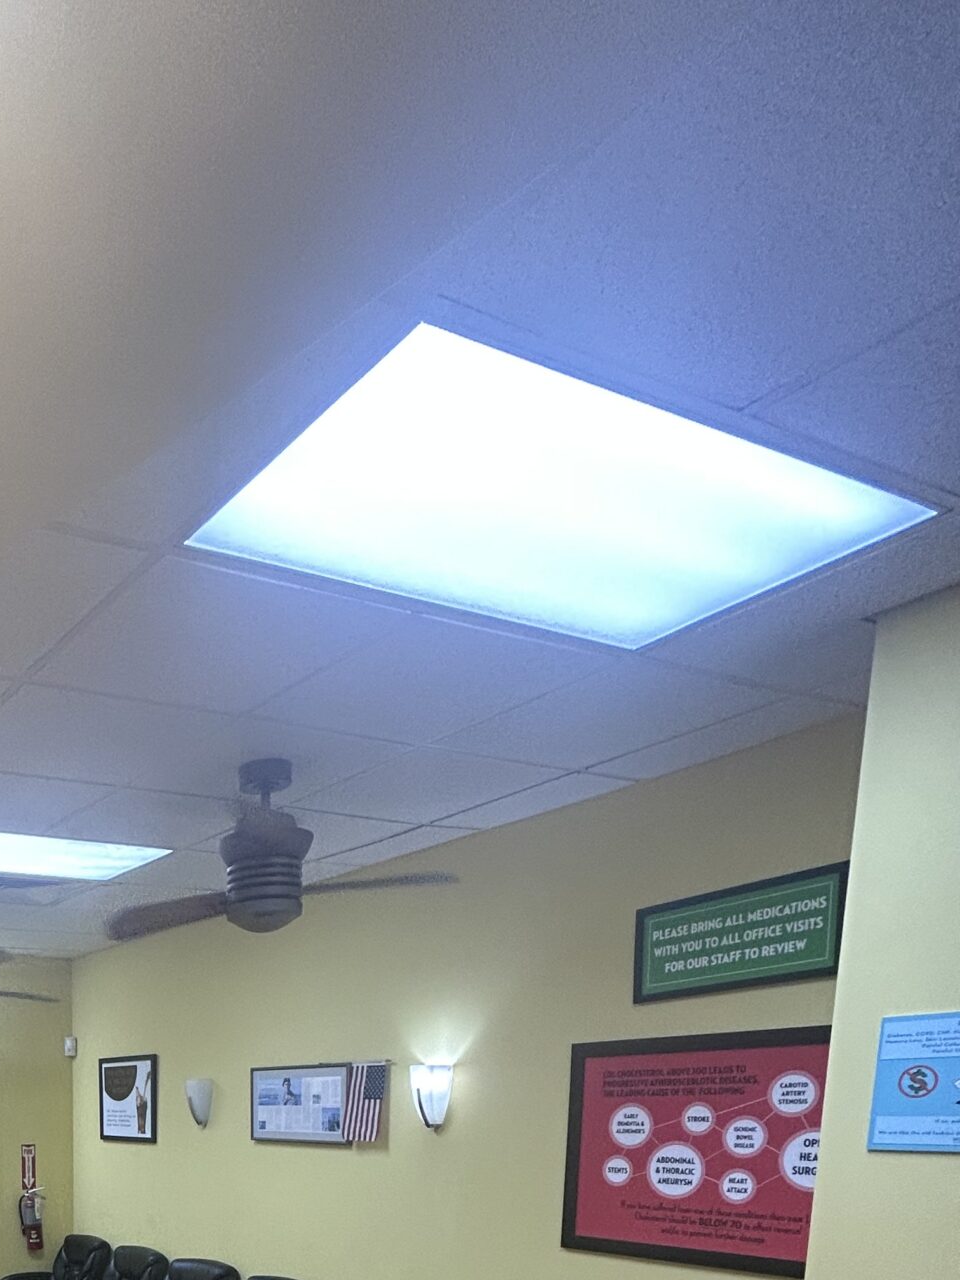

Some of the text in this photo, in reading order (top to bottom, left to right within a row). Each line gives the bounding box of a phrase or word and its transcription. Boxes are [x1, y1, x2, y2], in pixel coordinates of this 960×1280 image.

[652, 896, 827, 941] PLEASE BRING ALL MEDICATIONS
[654, 916, 824, 957] WITH YOU TO ALL OFFICE VISITS
[664, 939, 807, 973] FOR OUR STAFF TO REVIEW
[709, 1065, 734, 1075] LEADS
[736, 1064, 747, 1074] TO
[656, 1156, 696, 1165] ABDOMINAL
[607, 1166, 628, 1174] STENTS
[662, 1166, 695, 1175] THORACIC
[657, 1177, 693, 1186] ANEURYSM
[728, 1177, 748, 1185] HEART
[699, 1217, 728, 1228] BELOW
[729, 1220, 743, 1230] 70
